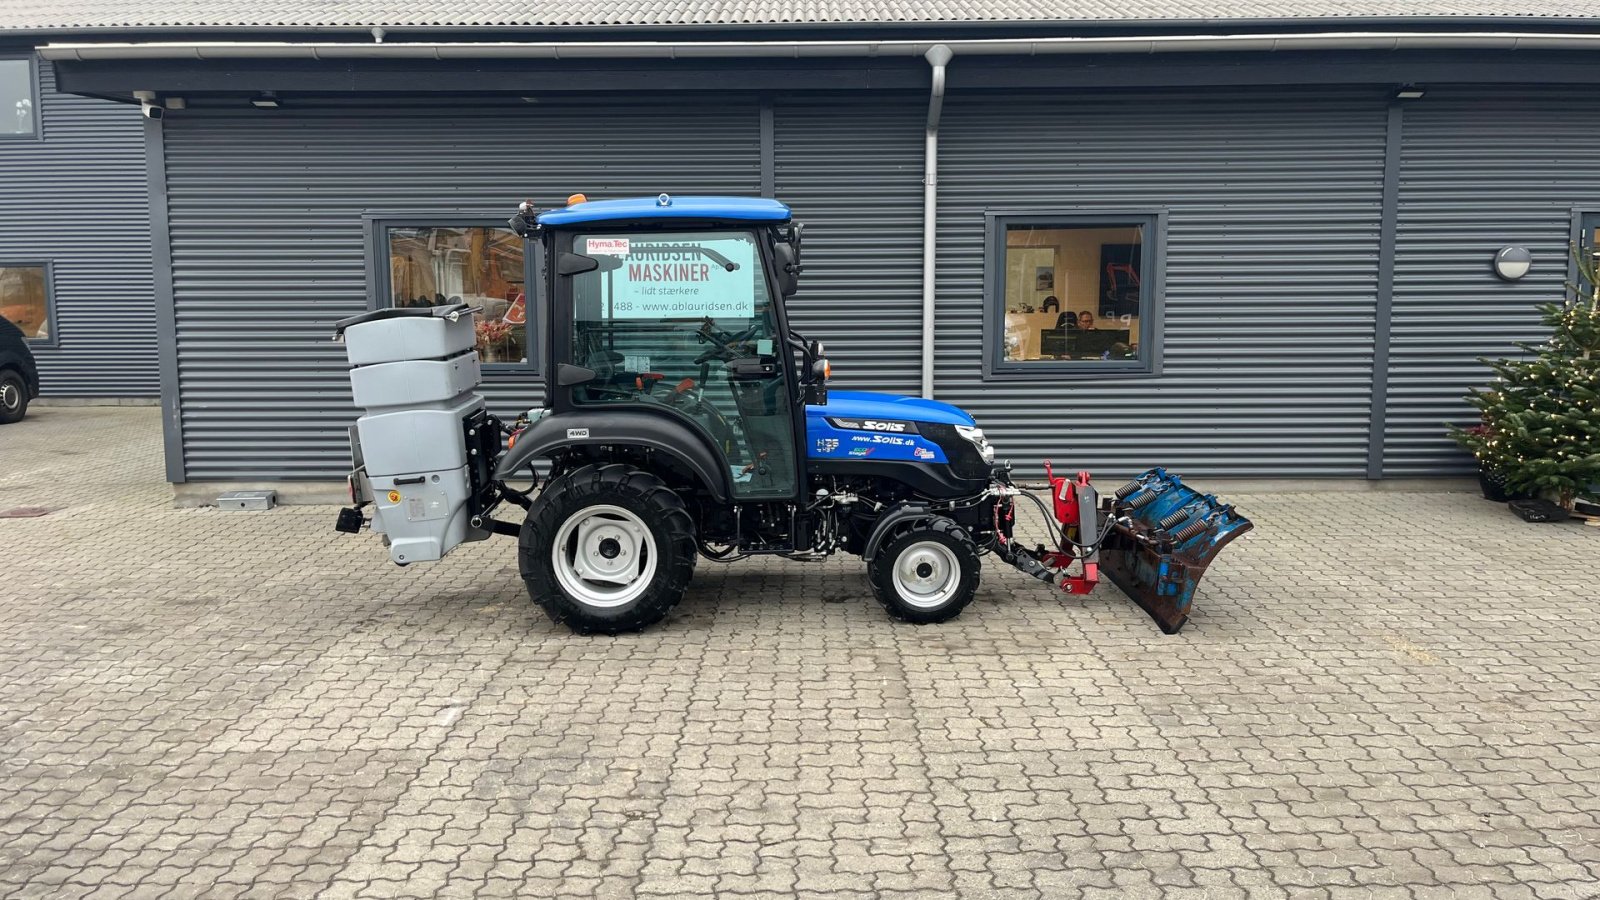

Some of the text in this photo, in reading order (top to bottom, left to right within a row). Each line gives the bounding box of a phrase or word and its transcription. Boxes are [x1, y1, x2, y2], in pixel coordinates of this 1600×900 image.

[628, 263, 710, 282] MASKINER
[641, 286, 656, 295] lidt
[658, 287, 699, 295] stærkere
[643, 302, 748, 311] www.ablauridsen.dk
